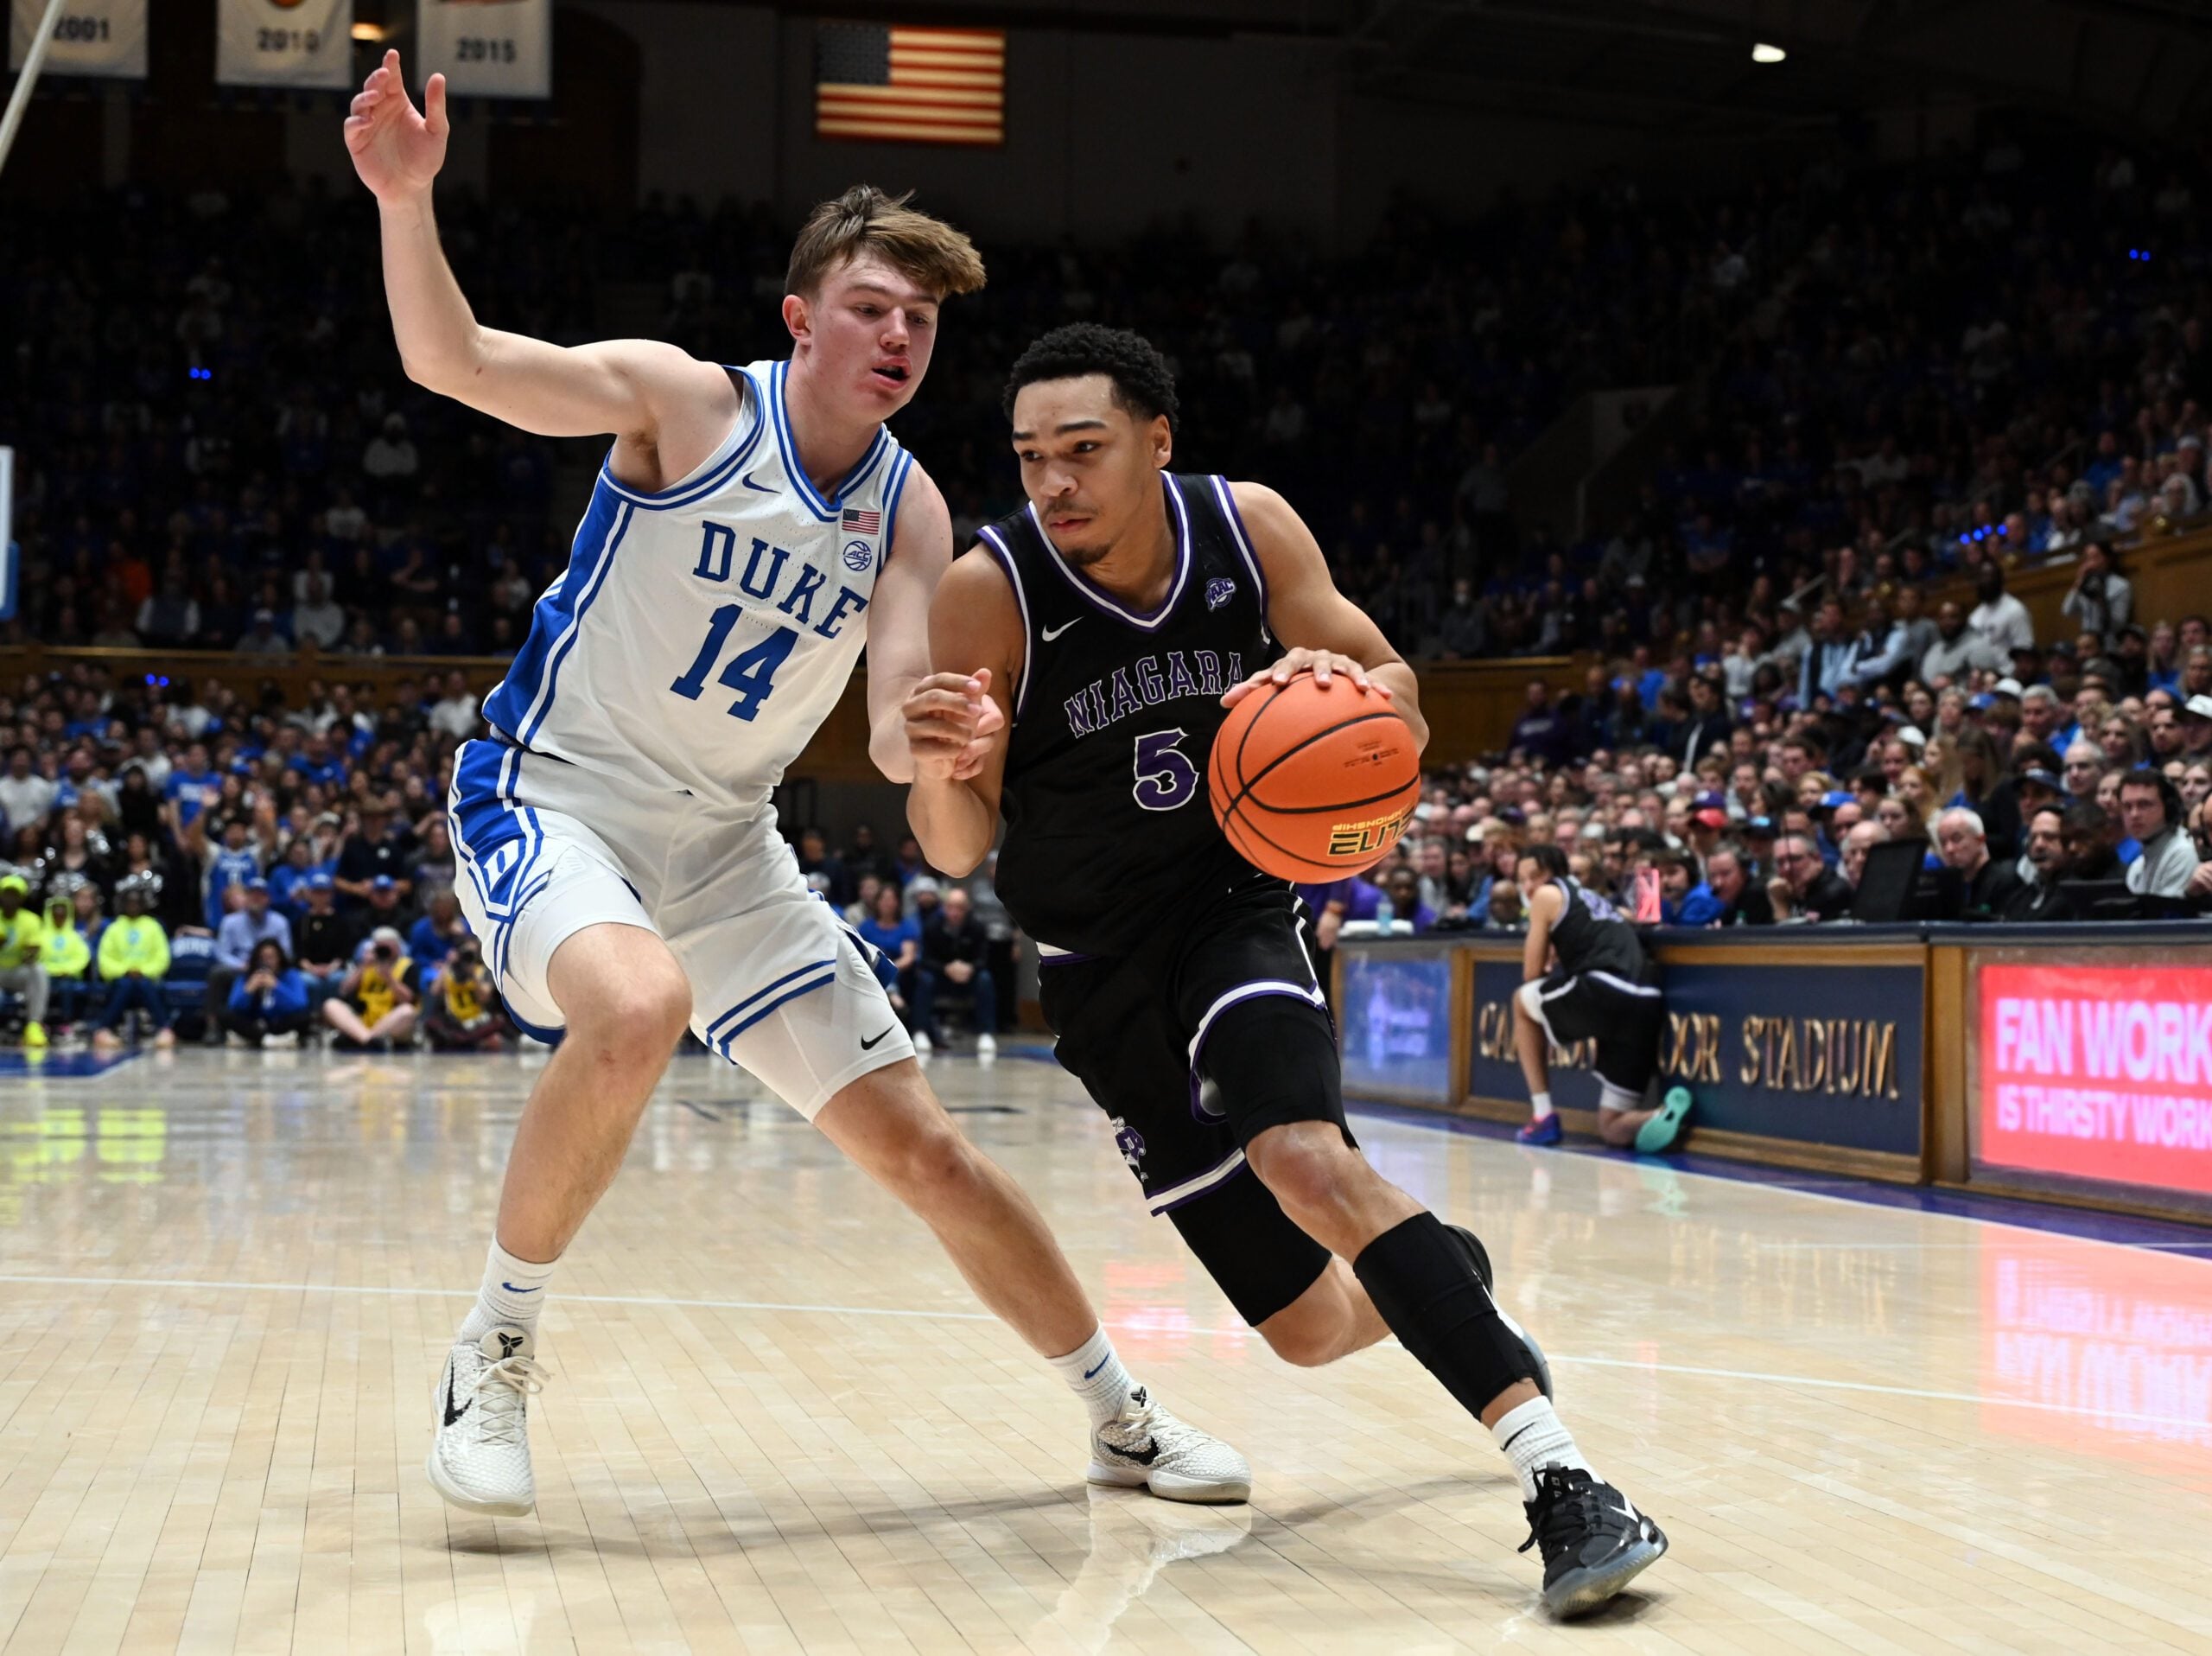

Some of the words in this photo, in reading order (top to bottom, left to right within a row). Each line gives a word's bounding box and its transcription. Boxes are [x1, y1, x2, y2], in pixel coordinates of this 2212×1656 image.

[258, 28, 321, 52] 2010
[456, 37, 517, 63] 2015
[693, 520, 868, 639] DUKE
[847, 550, 872, 562] ACC
[670, 604, 799, 722] 14
[1064, 650, 1243, 739] NIAGARA
[1133, 727, 1199, 811] 5
[1740, 1015, 1899, 1100] STADIUM
[1997, 997, 2073, 1076] FAN
[1997, 1084, 2021, 1131] IS
[2021, 1086, 2131, 1142] THIRSTY
